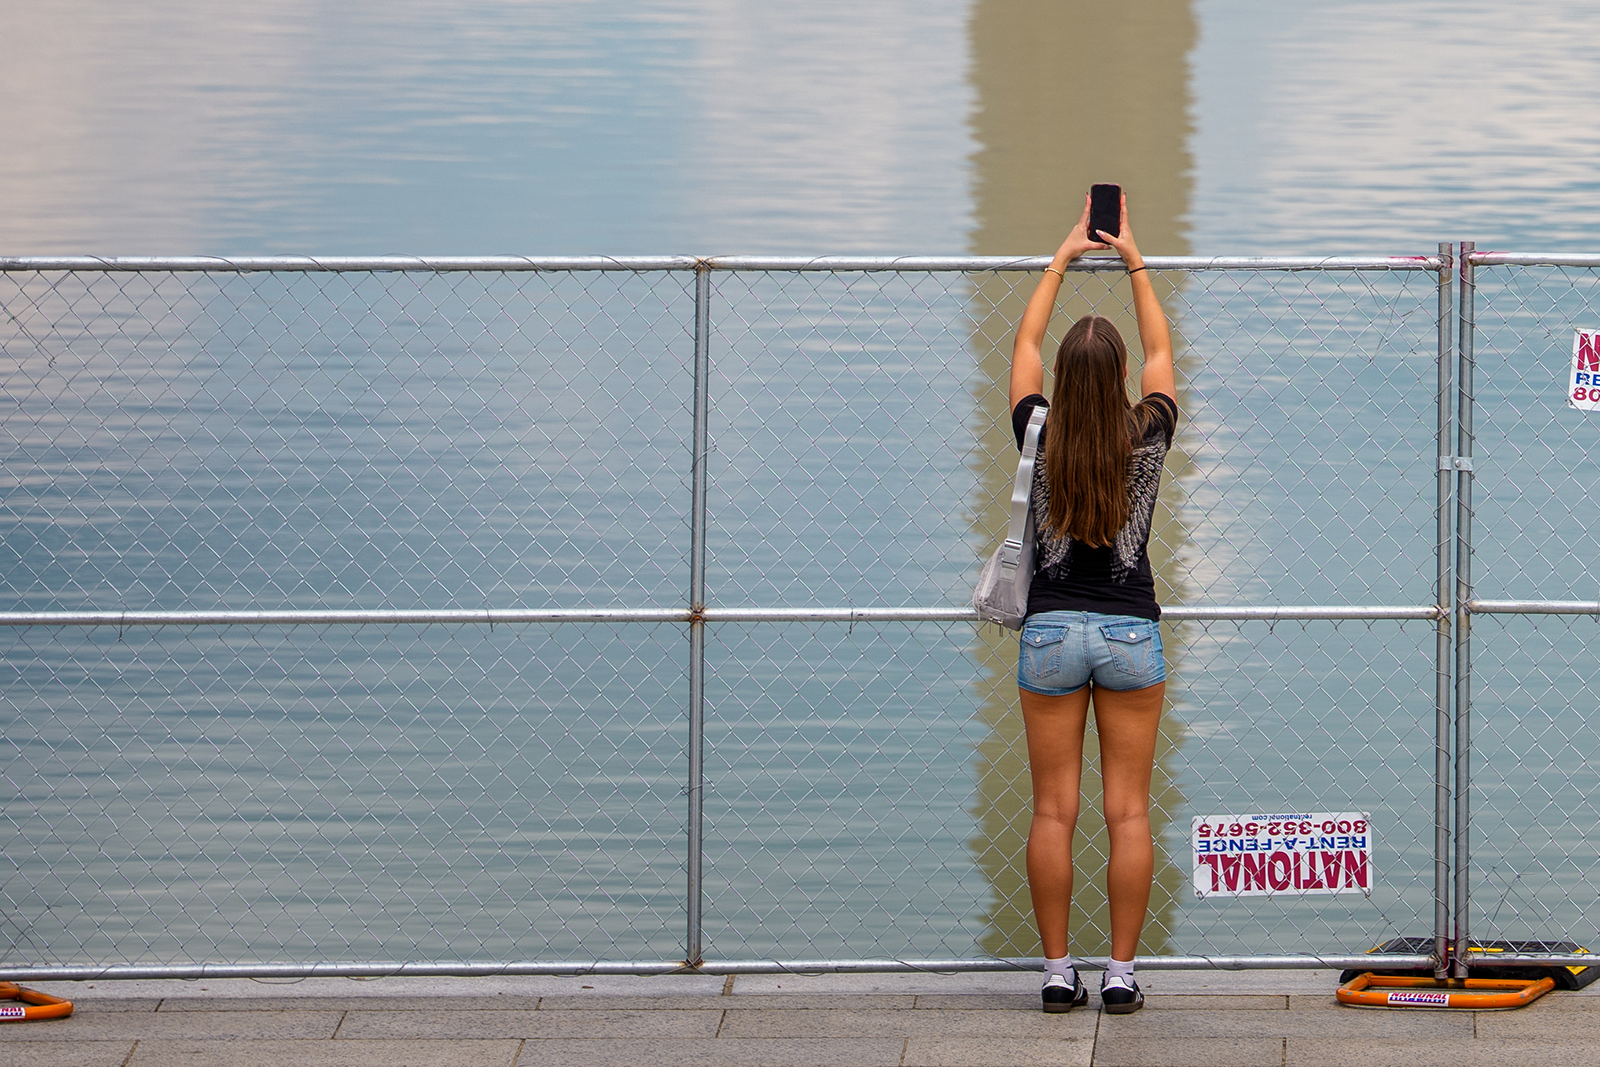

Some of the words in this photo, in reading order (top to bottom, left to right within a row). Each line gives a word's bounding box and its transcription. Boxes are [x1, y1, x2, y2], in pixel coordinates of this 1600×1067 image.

[1198, 820, 1367, 837] 800-352-5675
[1198, 836, 1367, 852] RENT-A-FENCE
[1198, 850, 1368, 892] NATIONAL
